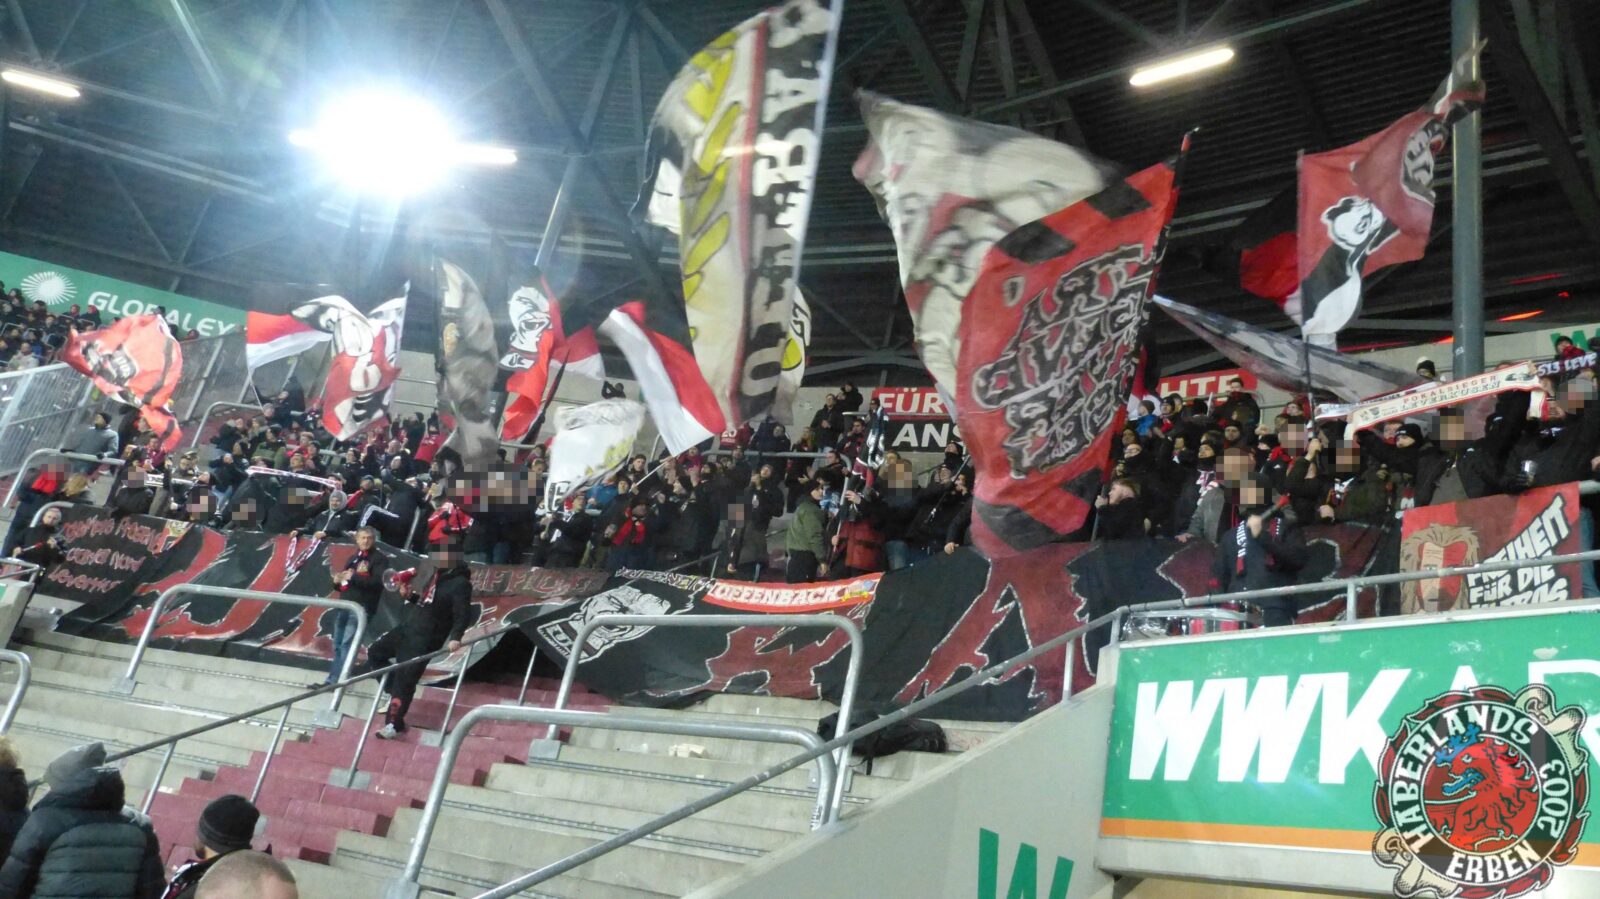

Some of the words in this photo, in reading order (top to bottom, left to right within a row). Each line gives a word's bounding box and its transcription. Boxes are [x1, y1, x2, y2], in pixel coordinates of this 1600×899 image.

[878, 387, 944, 413] FÜR
[1402, 381, 1501, 412] LEVERKUSEN
[1469, 573, 1513, 603] FÜR
[1129, 668, 1411, 785] WWK
